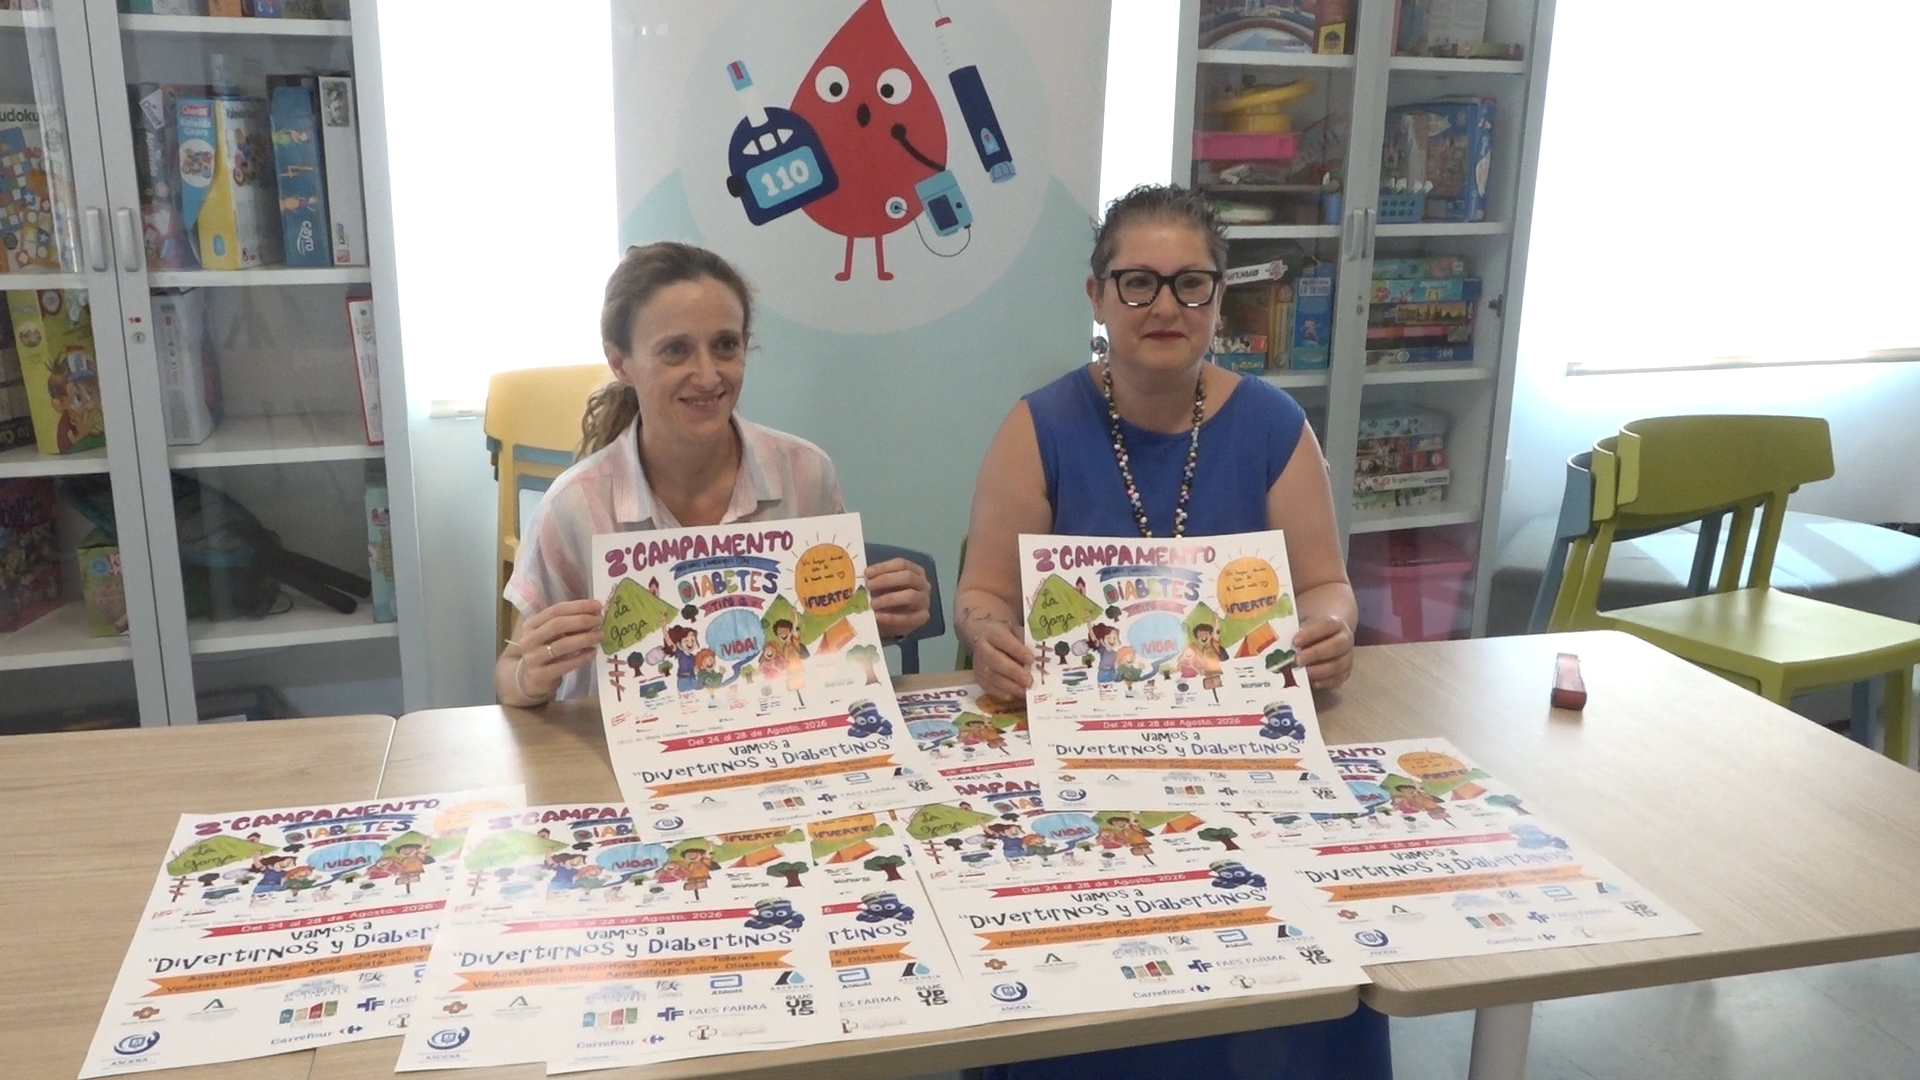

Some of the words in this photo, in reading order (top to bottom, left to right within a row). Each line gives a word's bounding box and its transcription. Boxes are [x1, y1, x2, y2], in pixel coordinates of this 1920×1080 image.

[760, 160, 811, 197] 110
[633, 531, 794, 571] CAMPAMENTO
[1059, 545, 1216, 570] CAMPAMENTO
[1041, 588, 1058, 609] La
[613, 596, 631, 618] La
[720, 637, 759, 657] ¡VIDA!
[1103, 721, 1118, 729] Del
[1148, 720, 1160, 728] 28
[1217, 717, 1241, 726] 2026
[687, 738, 704, 747] Del
[708, 736, 719, 744] 24
[735, 732, 747, 740] 28
[751, 729, 763, 737] de
[805, 720, 828, 730] 2026
[1193, 733, 1201, 741] a
[782, 740, 790, 749] a
[1176, 746, 1186, 757] y
[766, 756, 777, 768] y
[232, 799, 440, 831] CAMPAMENTO
[725, 829, 787, 843] ¡FUERTE!
[813, 825, 873, 839] ¡FUERTE!
[1449, 848, 1459, 857] a
[323, 855, 373, 869] ¡VIDA!
[611, 857, 659, 870] ¡VIDA!
[1437, 861, 1455, 874] y
[1158, 873, 1187, 881] 2026
[1134, 888, 1144, 897] a
[1116, 903, 1132, 917] y
[241, 924, 260, 933] Del
[268, 922, 283, 930] 24
[306, 917, 322, 925] 28
[327, 914, 343, 922] de
[402, 903, 433, 912] 2026
[600, 918, 616, 926] 28
[621, 916, 637, 924] de
[692, 911, 723, 920] 2026
[362, 922, 373, 930] a
[656, 926, 665, 935] a
[331, 939, 345, 954] y
[626, 943, 638, 958] y
[1246, 953, 1286, 965] FARMA
[858, 994, 902, 1006] FARMA
[689, 1006, 720, 1015] FAES
[723, 1003, 768, 1013] FARMA
[270, 1030, 333, 1046] Carrefour
[577, 1038, 635, 1049] Carrefour
